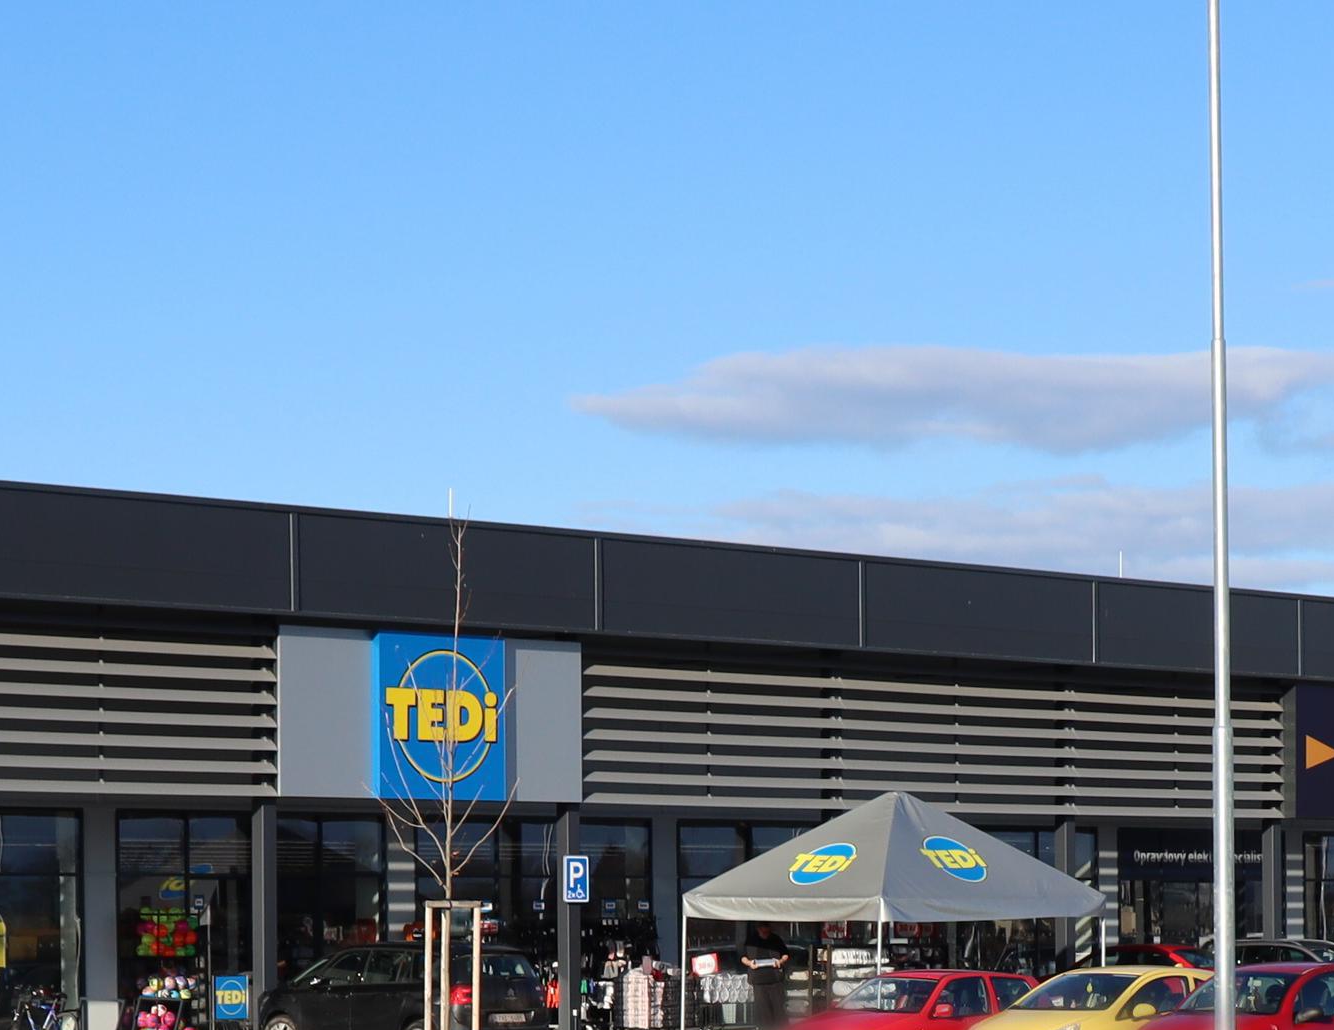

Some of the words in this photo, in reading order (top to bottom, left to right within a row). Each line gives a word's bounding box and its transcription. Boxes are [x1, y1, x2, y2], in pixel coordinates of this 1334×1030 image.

[385, 687, 499, 743] TEDi
[788, 852, 857, 873] TEDi
[920, 847, 988, 870] TEDi
[570, 861, 584, 889] P
[216, 989, 246, 1005] TEDi
